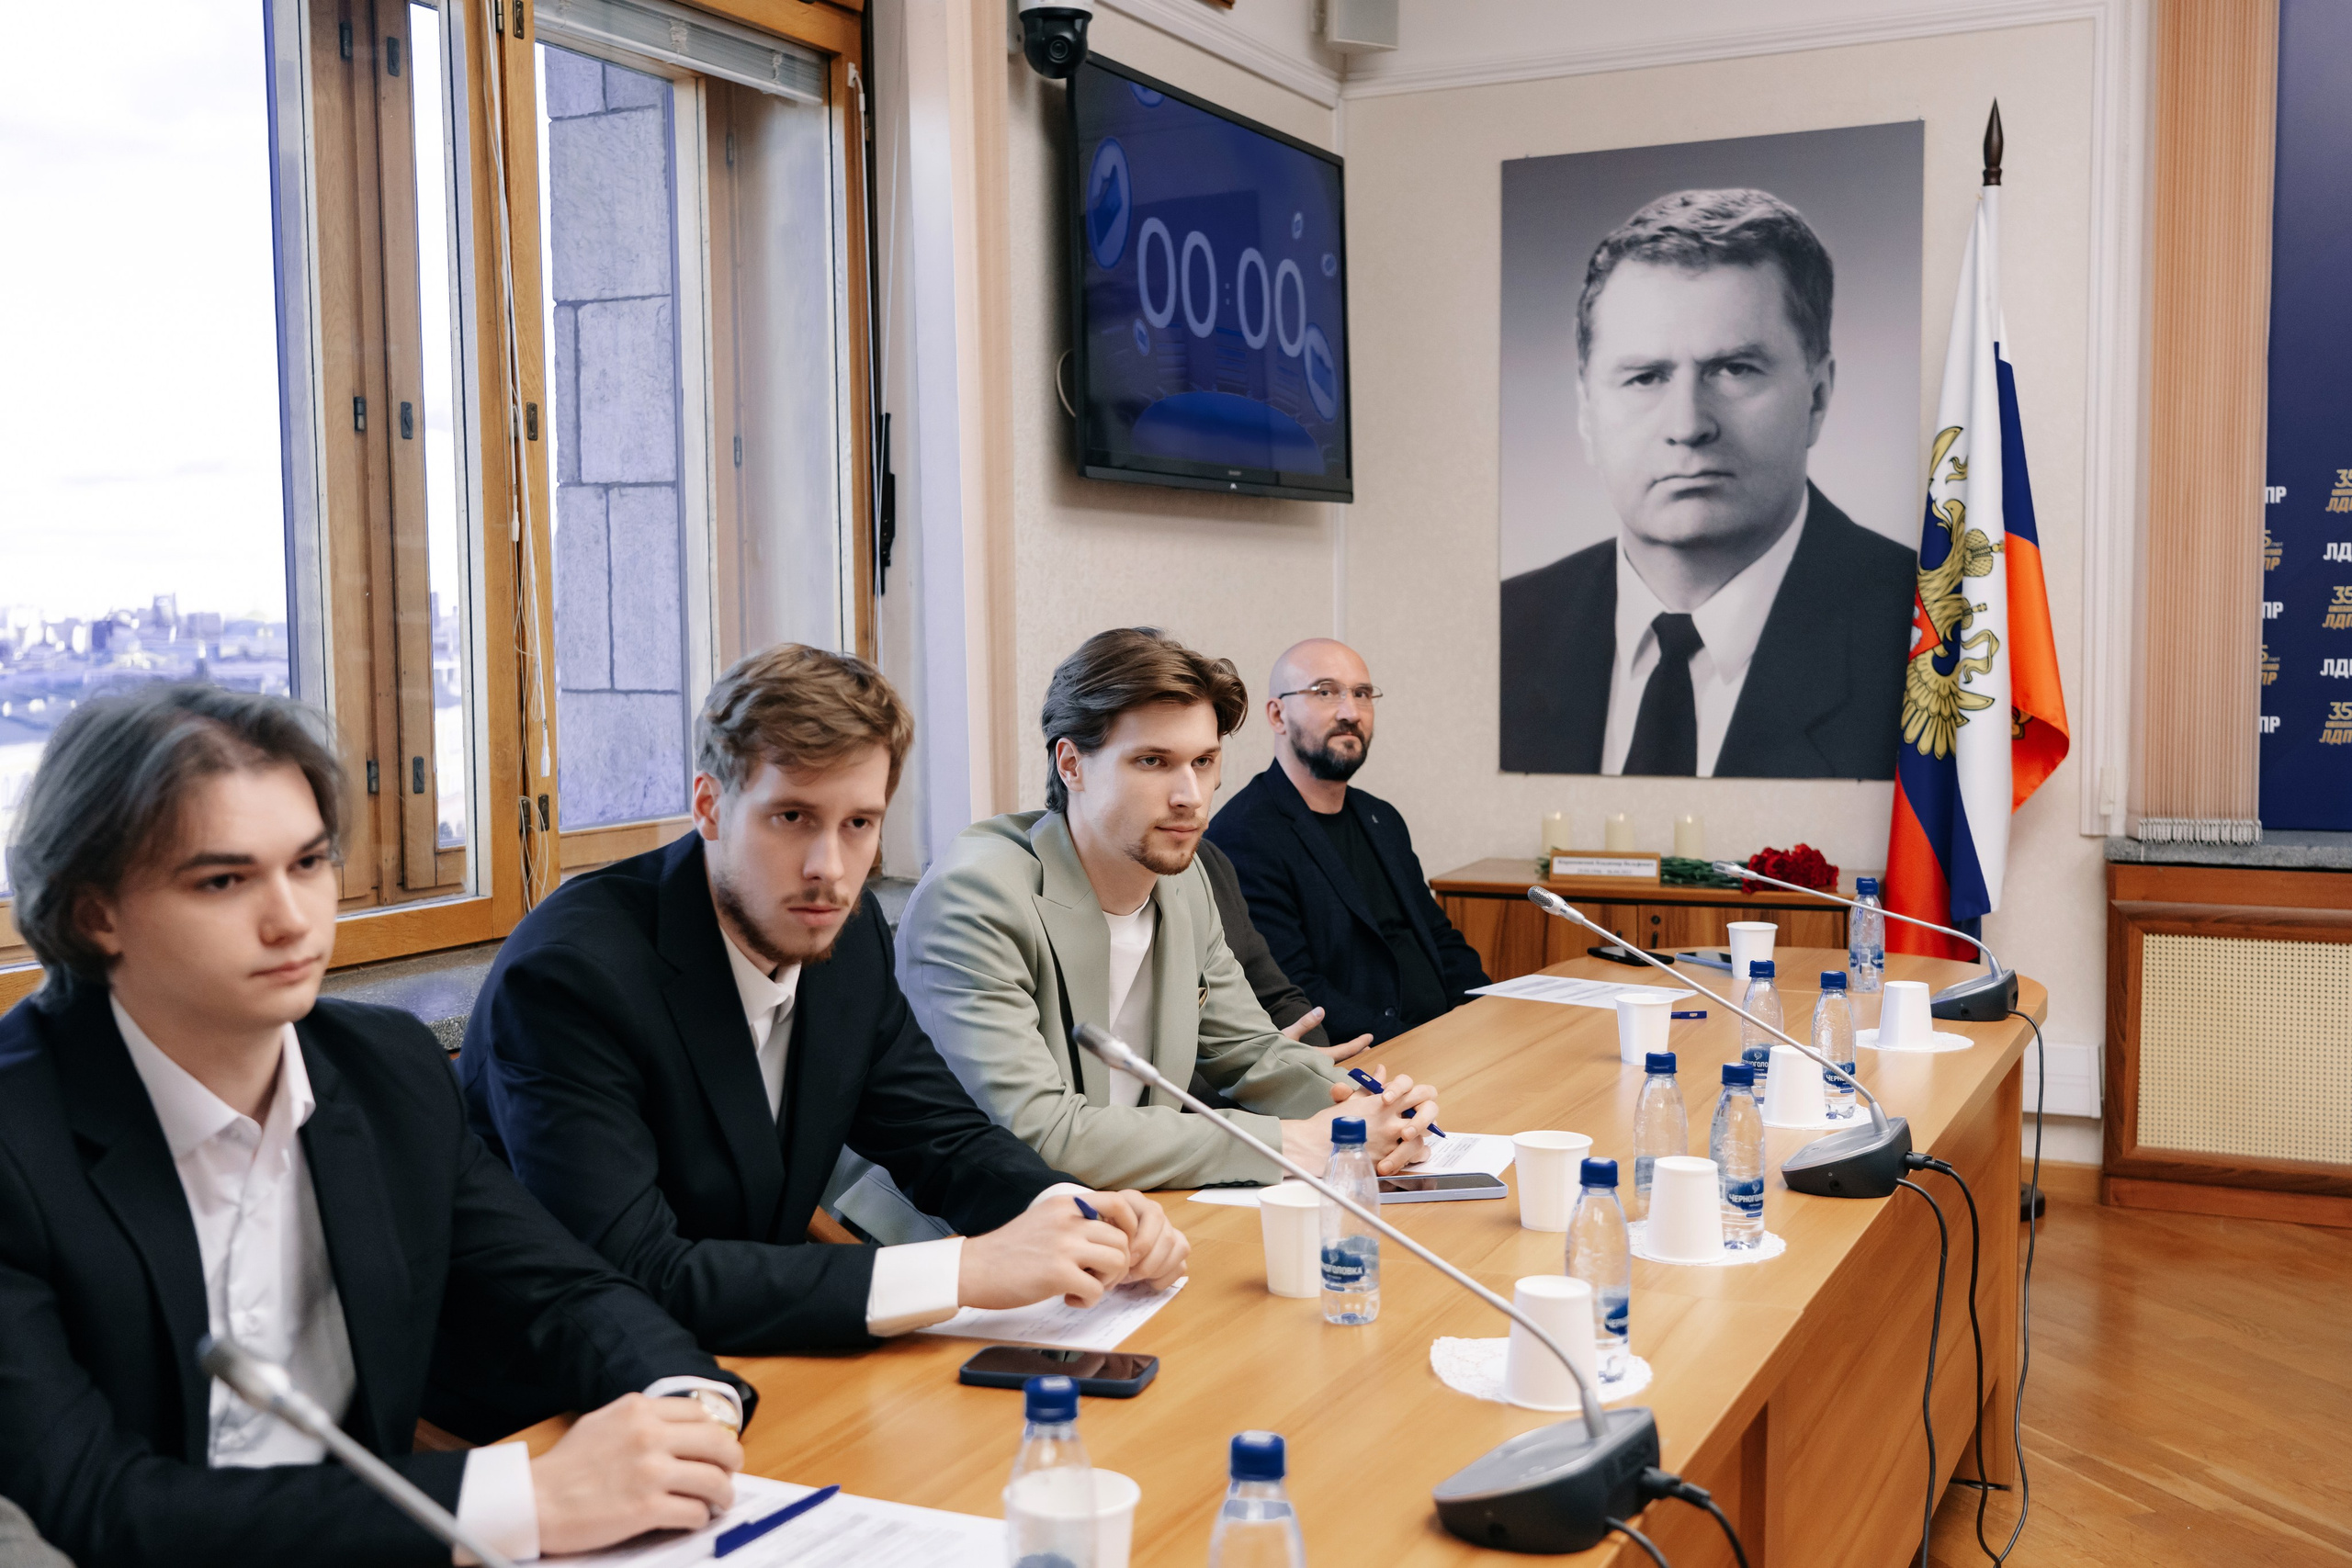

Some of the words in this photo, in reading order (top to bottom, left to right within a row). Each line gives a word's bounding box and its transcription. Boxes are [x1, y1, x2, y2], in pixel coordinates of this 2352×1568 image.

[1137, 217, 1306, 357] 00:00
[2325, 497, 2352, 513] ЛД
[2320, 659, 2352, 679] ЛД
[2328, 702, 2352, 720] 35
